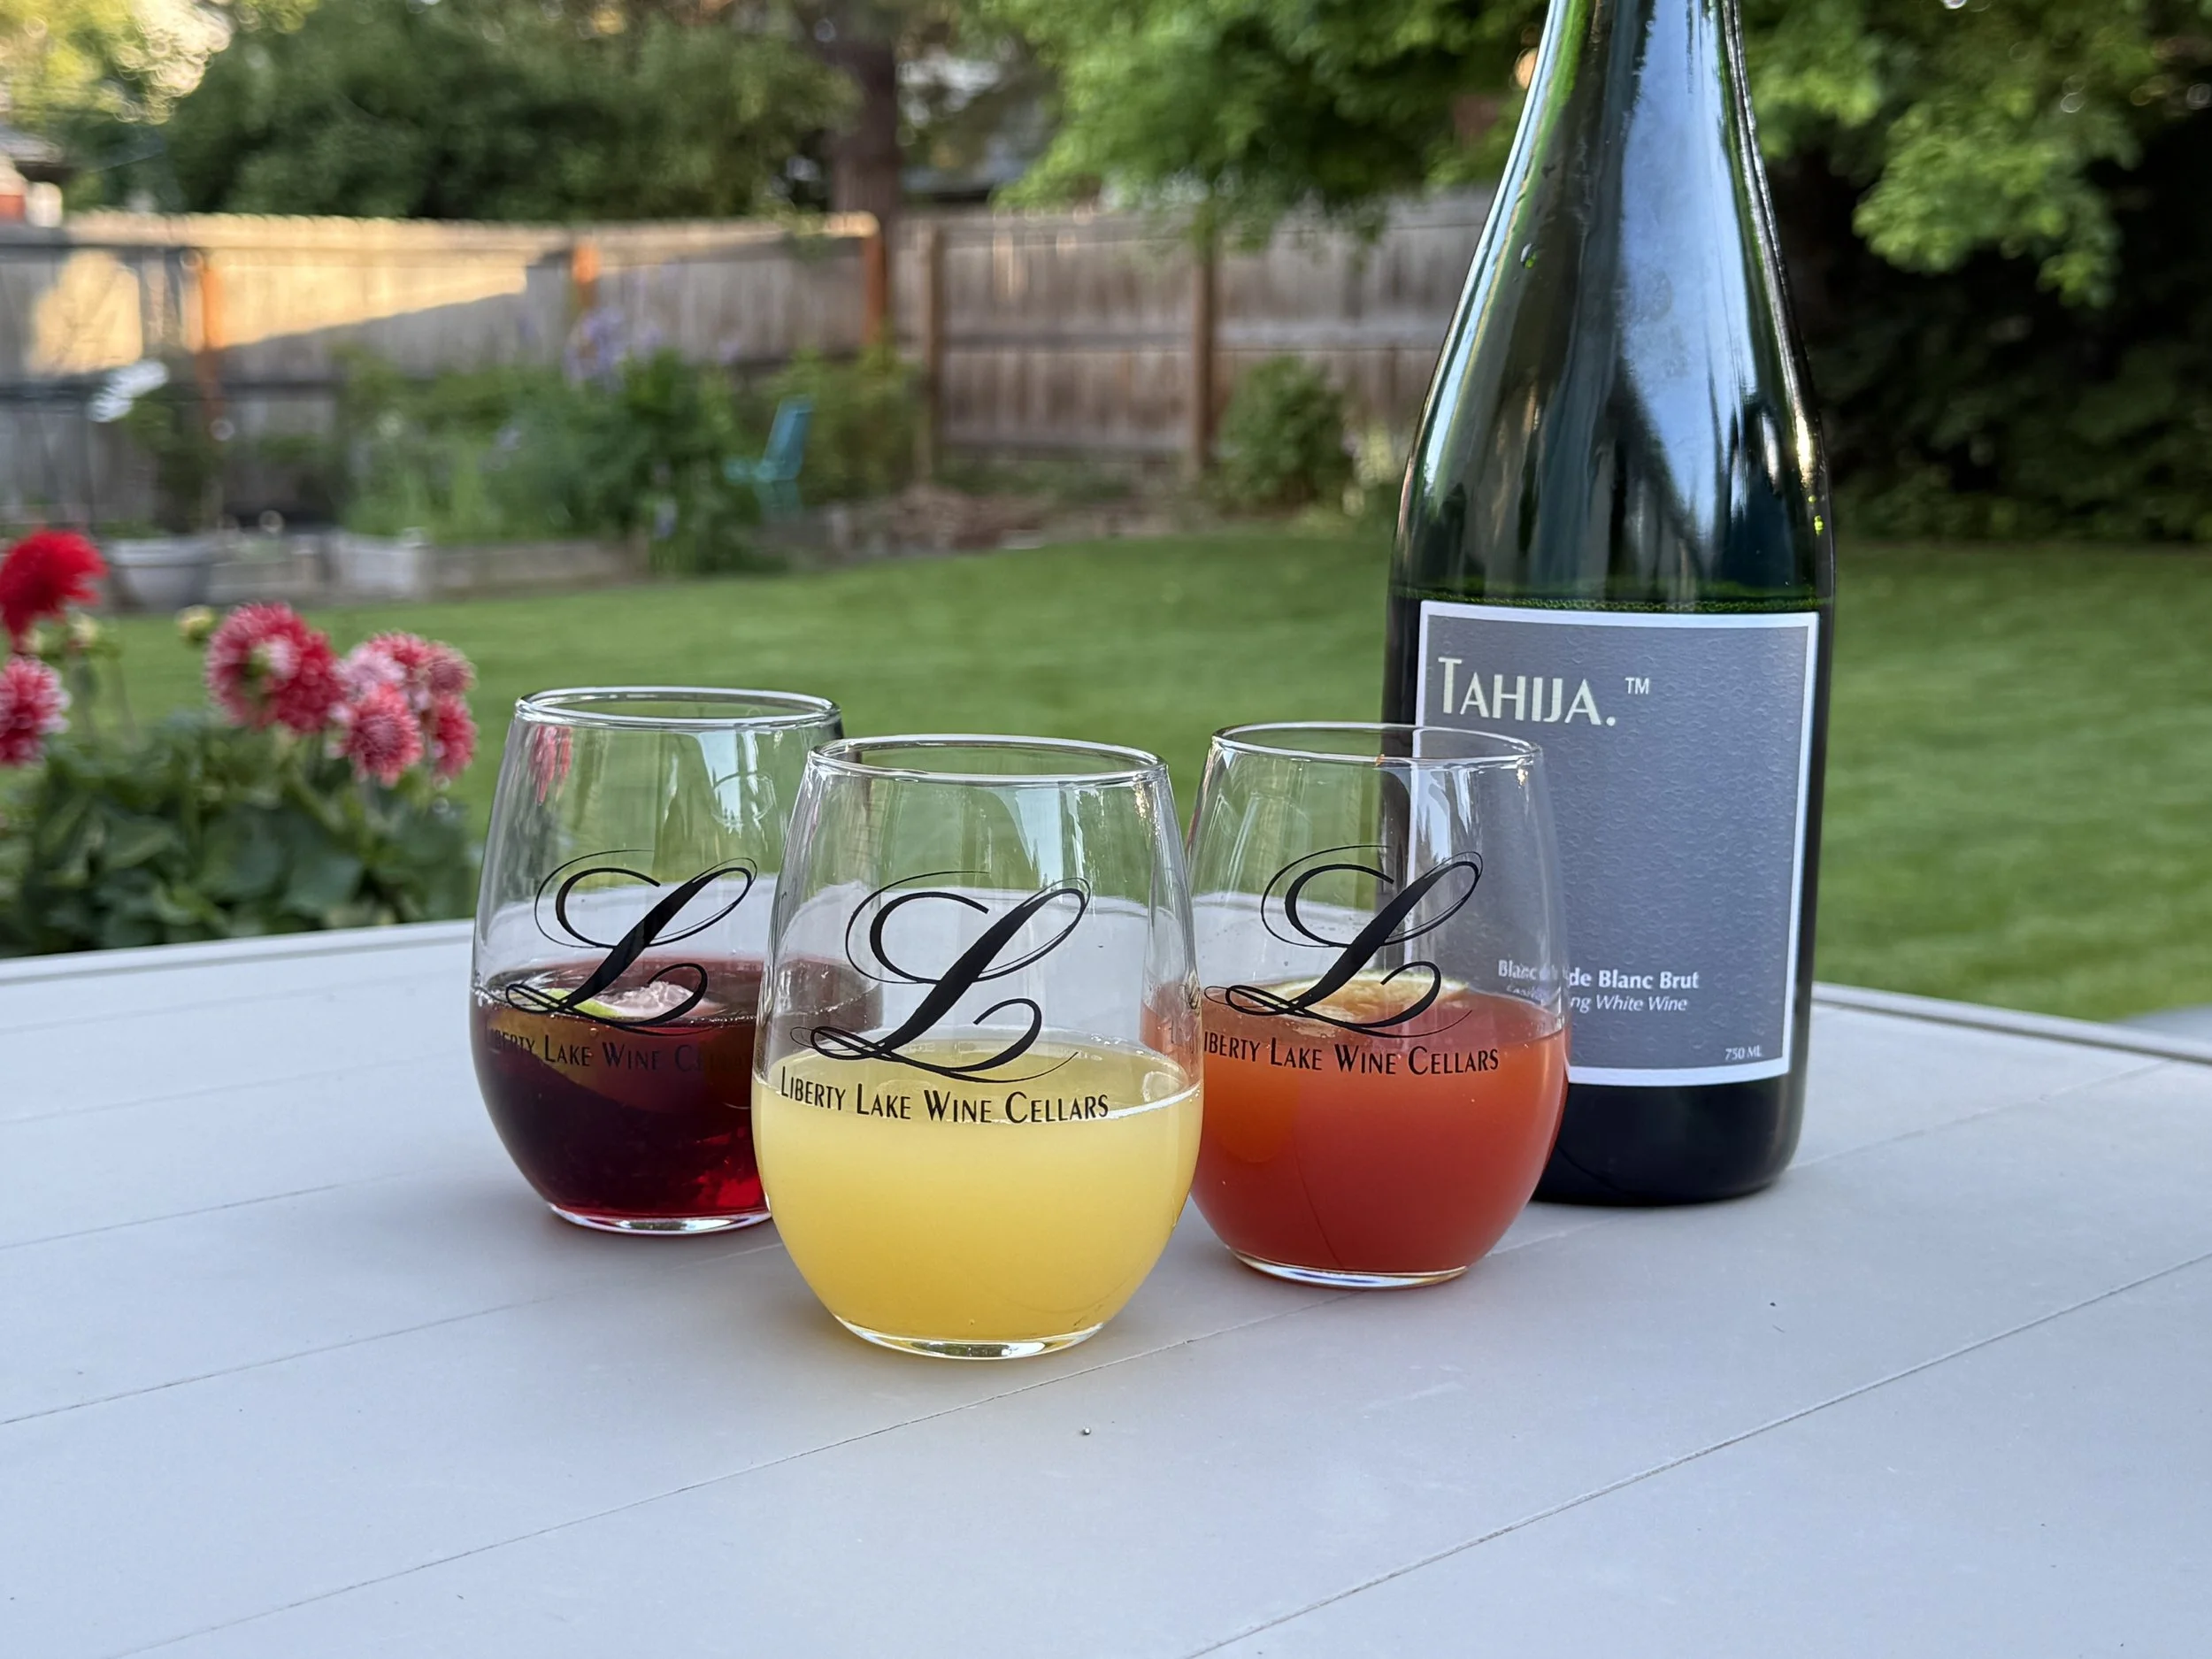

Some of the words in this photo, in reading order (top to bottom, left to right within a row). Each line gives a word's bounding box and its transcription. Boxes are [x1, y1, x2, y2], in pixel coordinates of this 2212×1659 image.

[1438, 657, 1616, 726] TAHIJA.
[1598, 969, 1653, 990] Blanc
[1659, 971, 1700, 990] Brut
[1595, 994, 1644, 1012] White
[1648, 996, 1688, 1012] Wine
[487, 1026, 535, 1054] IBERTY
[544, 1034, 592, 1067] LAKE
[603, 1041, 661, 1071] WINE
[1203, 1031, 1261, 1063] IBERTY
[1270, 1037, 1323, 1071] LAKE
[1334, 1044, 1396, 1075] WINE
[1408, 1046, 1499, 1076] CELLARS
[1725, 1047, 1746, 1060] 750
[780, 1065, 847, 1111] LIBERTY
[856, 1083, 911, 1119] LAKE
[924, 1089, 992, 1123] WINE
[1005, 1090, 1109, 1124] CELLARS
